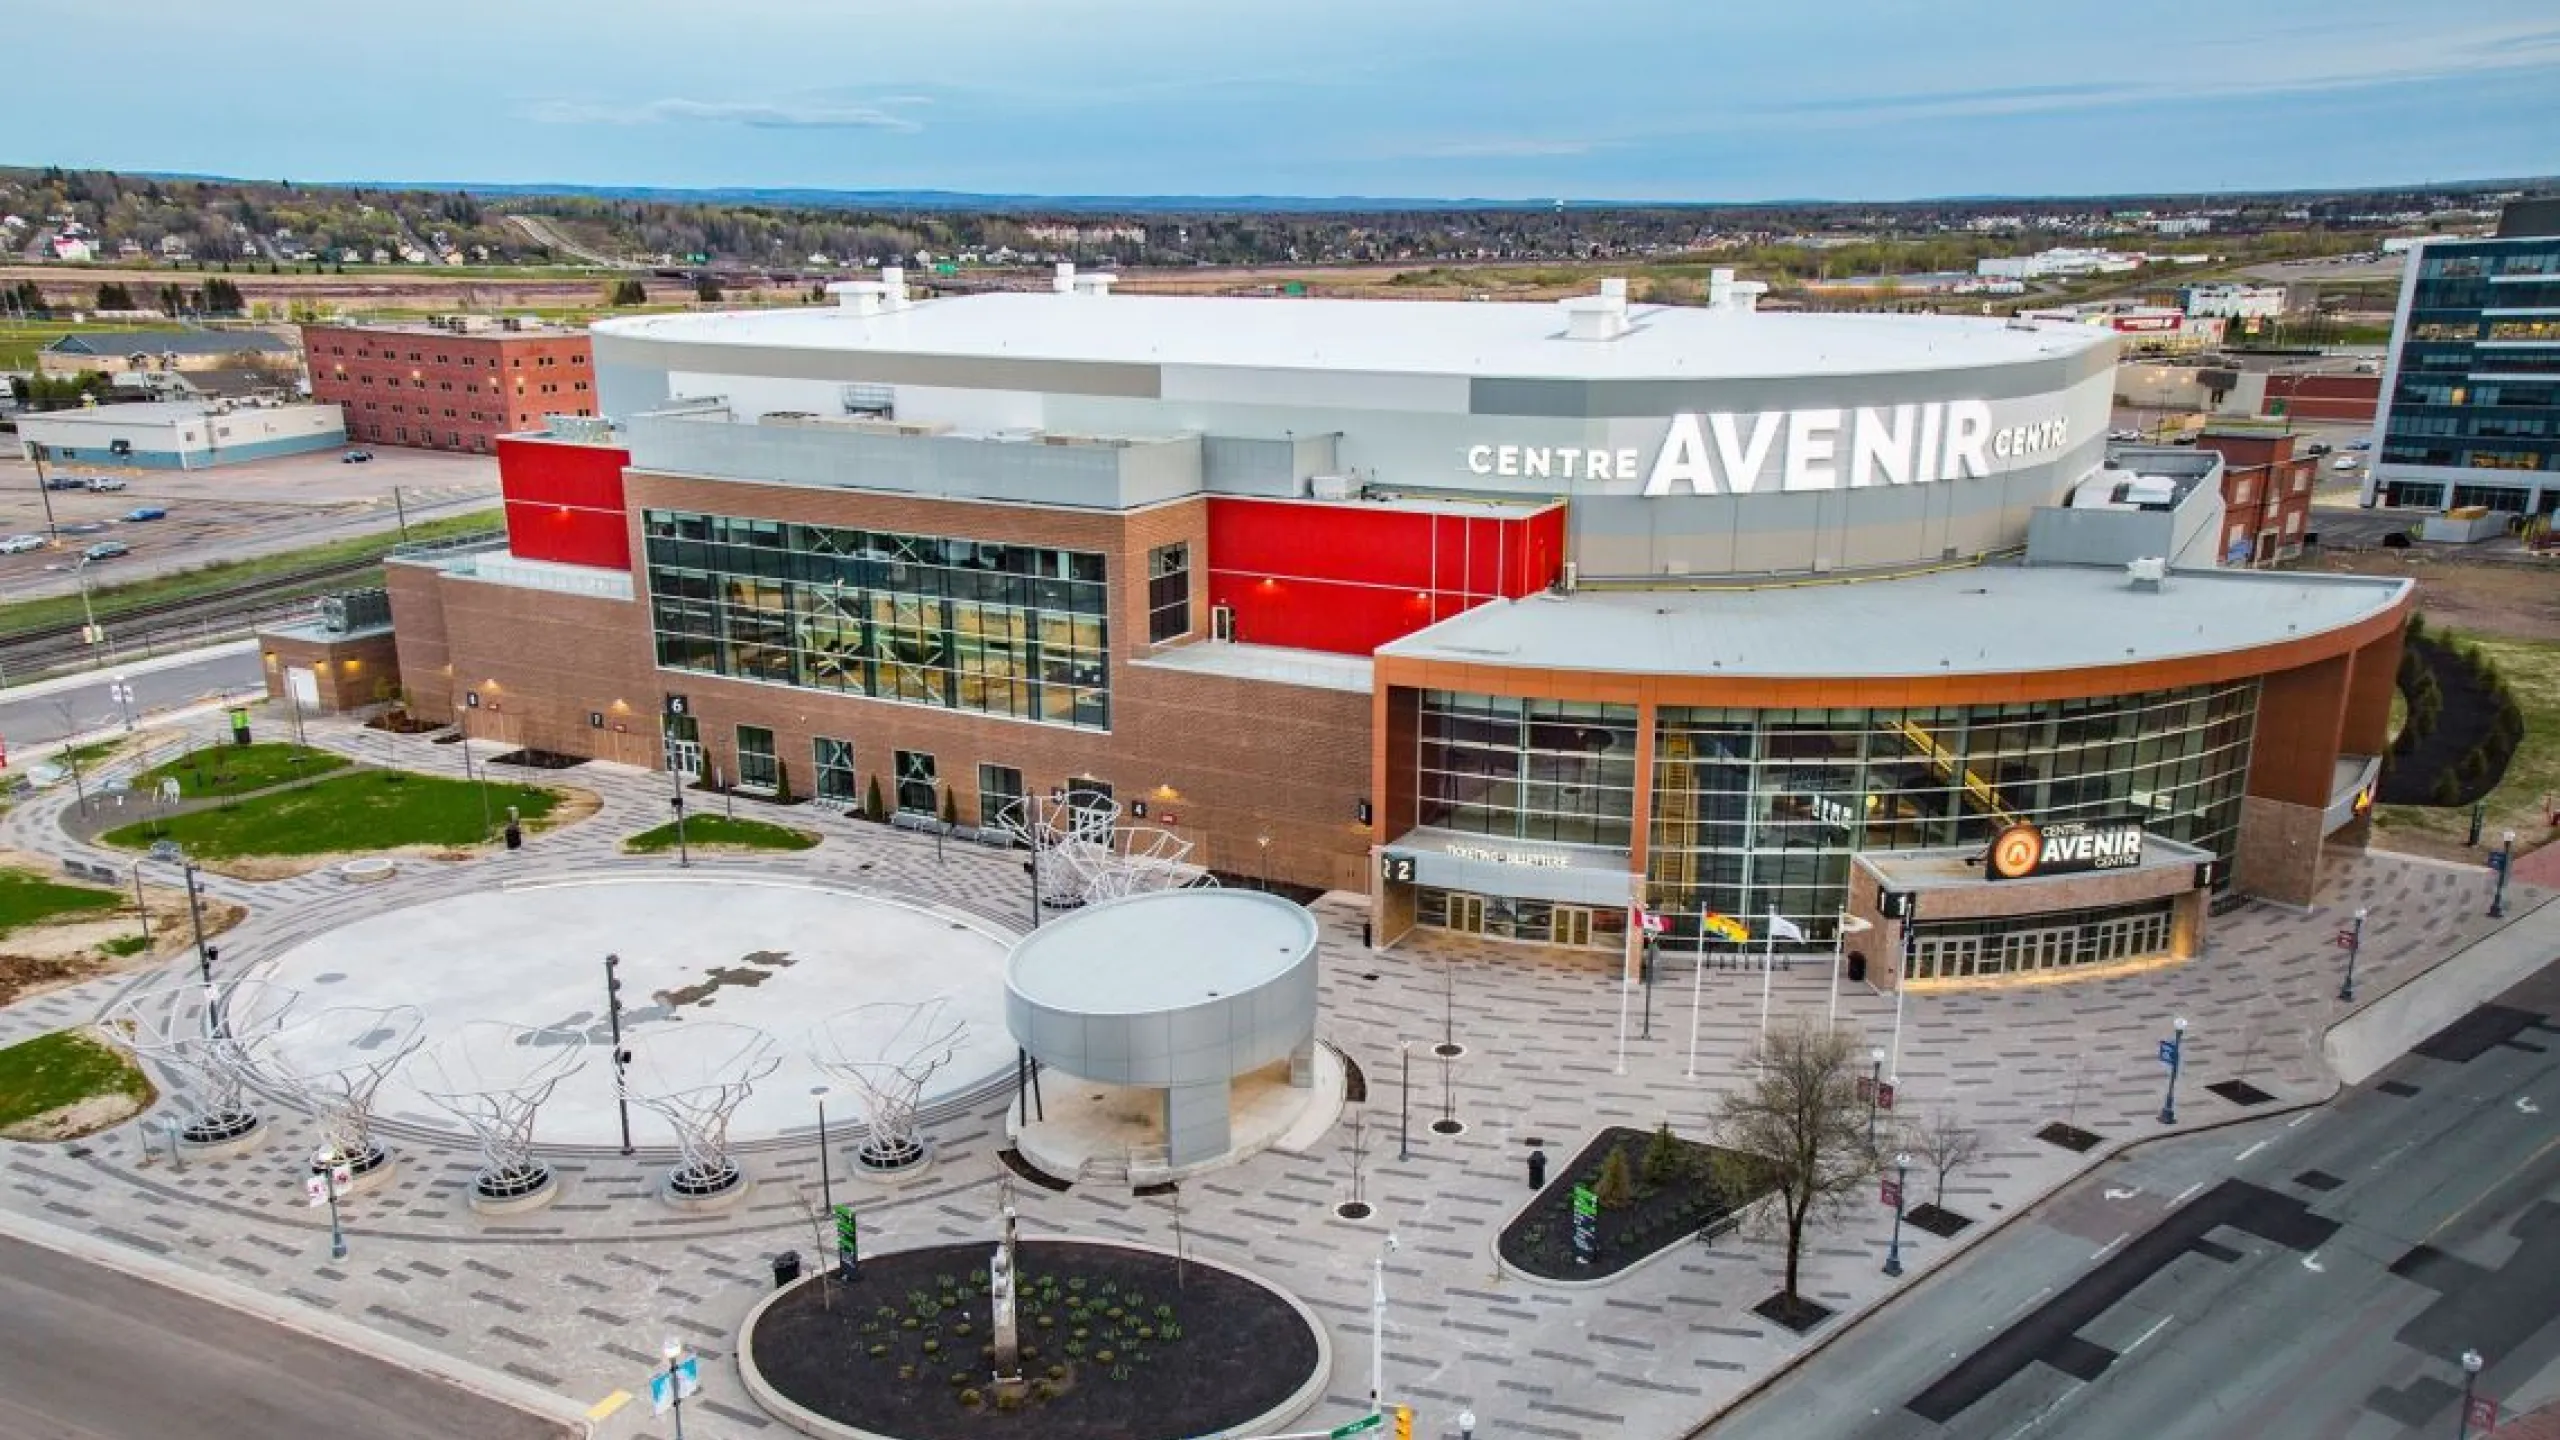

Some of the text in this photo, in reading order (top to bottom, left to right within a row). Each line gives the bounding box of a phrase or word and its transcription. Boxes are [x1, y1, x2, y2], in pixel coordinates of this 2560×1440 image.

[1468, 444, 1638, 479] CENTRE
[1644, 399, 1992, 497] AVENIR
[673, 699, 683, 713] 6
[2041, 822, 2086, 837] CENTRE
[2040, 830, 2140, 861] AVENIR
[1398, 861, 1409, 879] 2
[2095, 854, 2139, 868] CENTRE
[1898, 896, 1905, 916] 1
